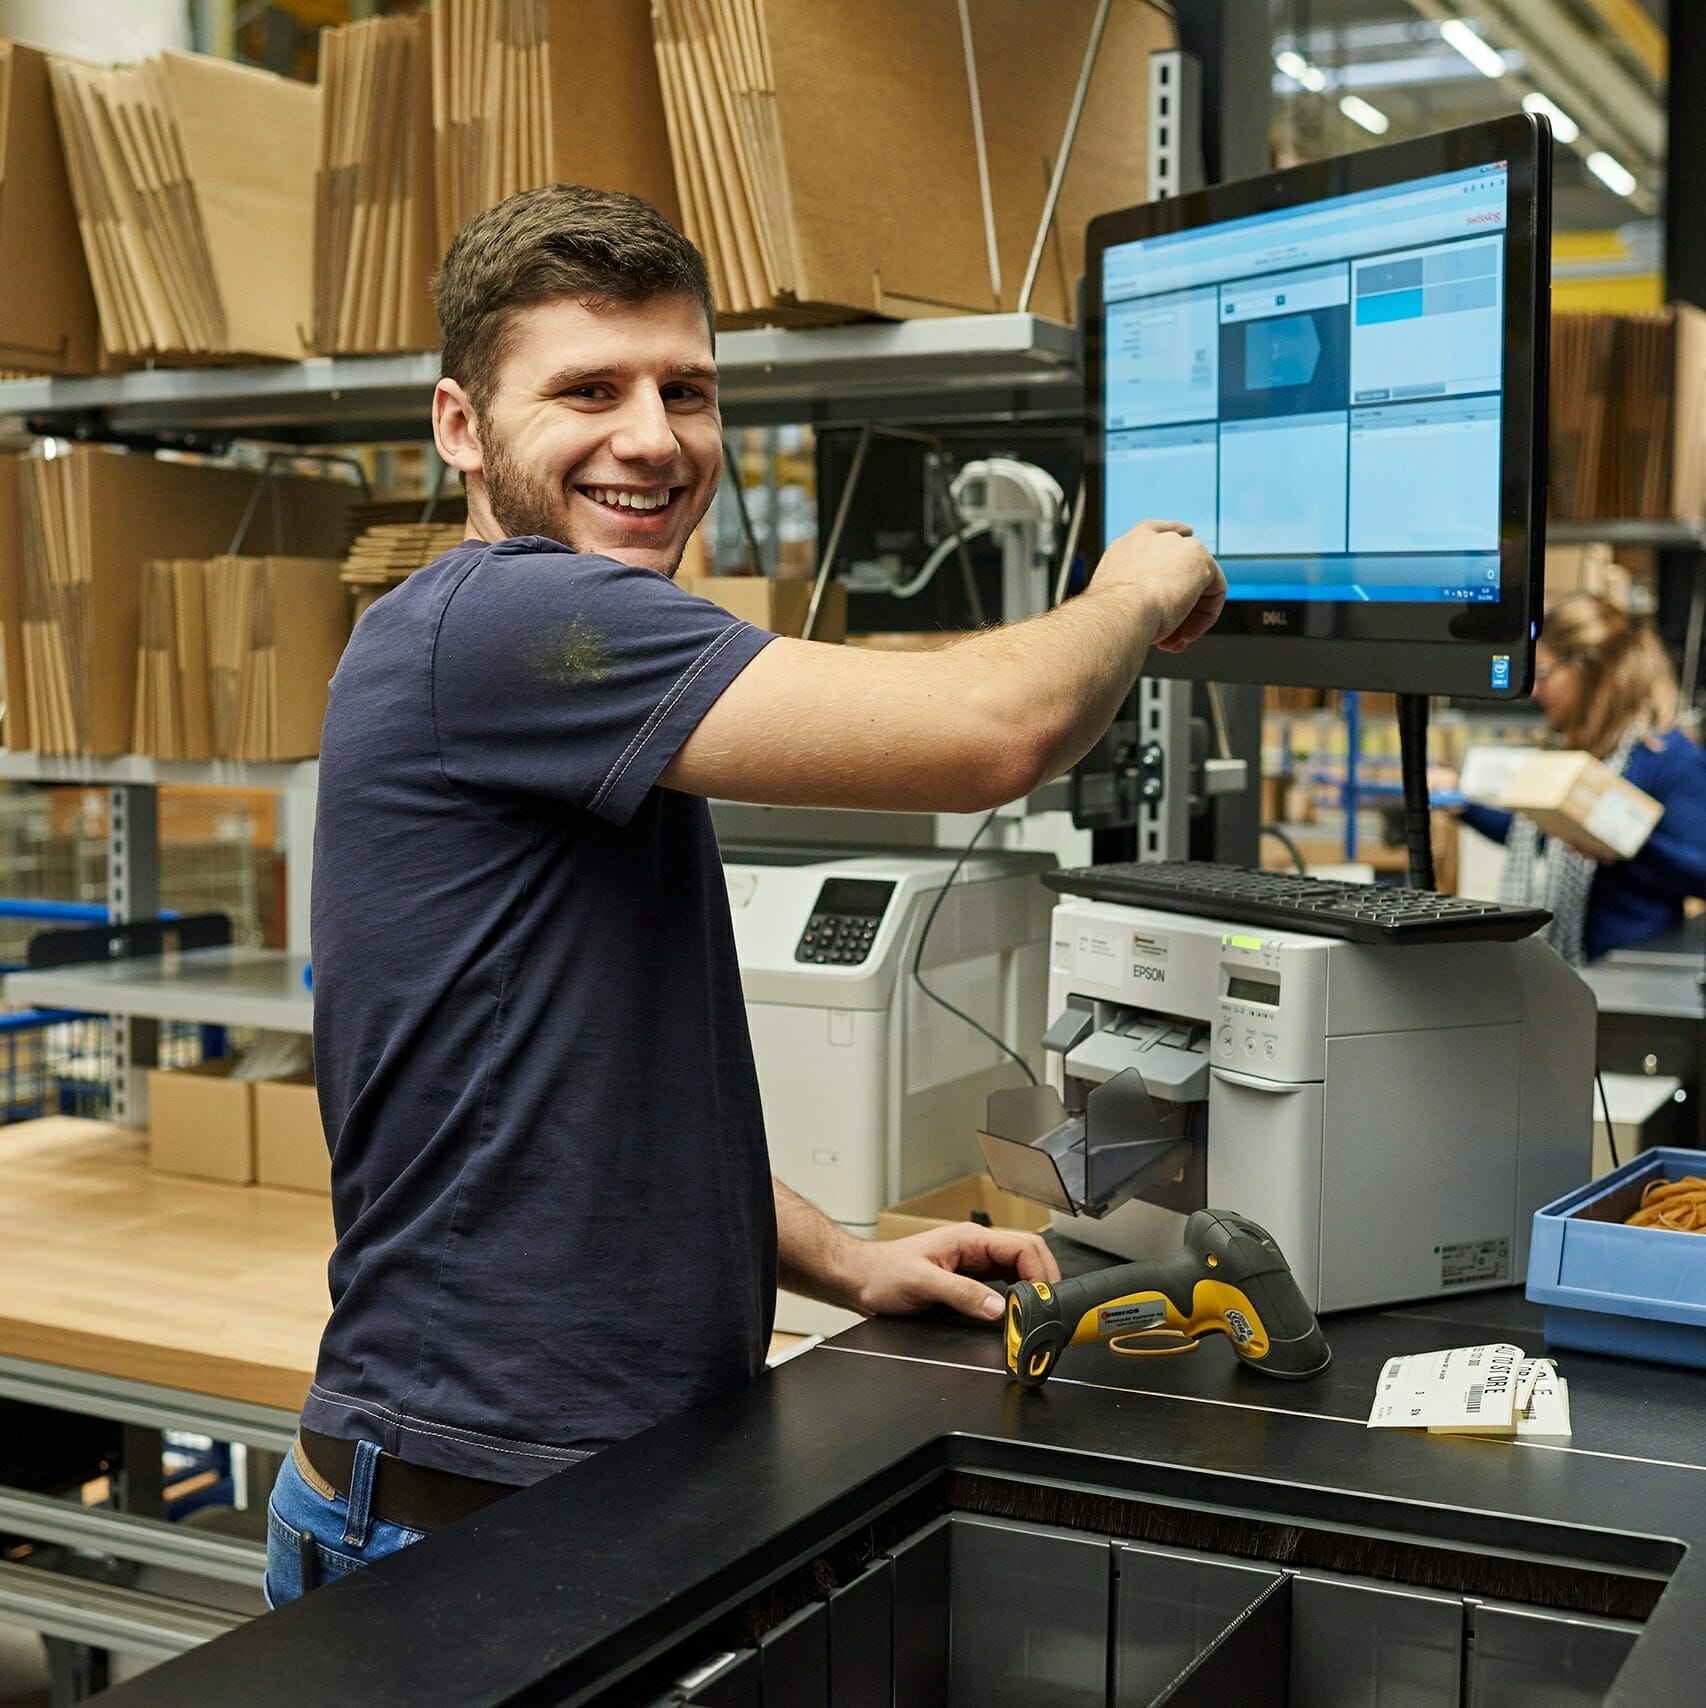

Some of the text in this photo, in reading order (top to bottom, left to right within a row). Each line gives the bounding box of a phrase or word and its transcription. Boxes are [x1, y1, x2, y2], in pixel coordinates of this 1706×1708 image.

[1263, 610, 1288, 625] DELL
[1133, 964, 1166, 982] EPSON
[1484, 1345, 1516, 1394] AUTOSTORE
